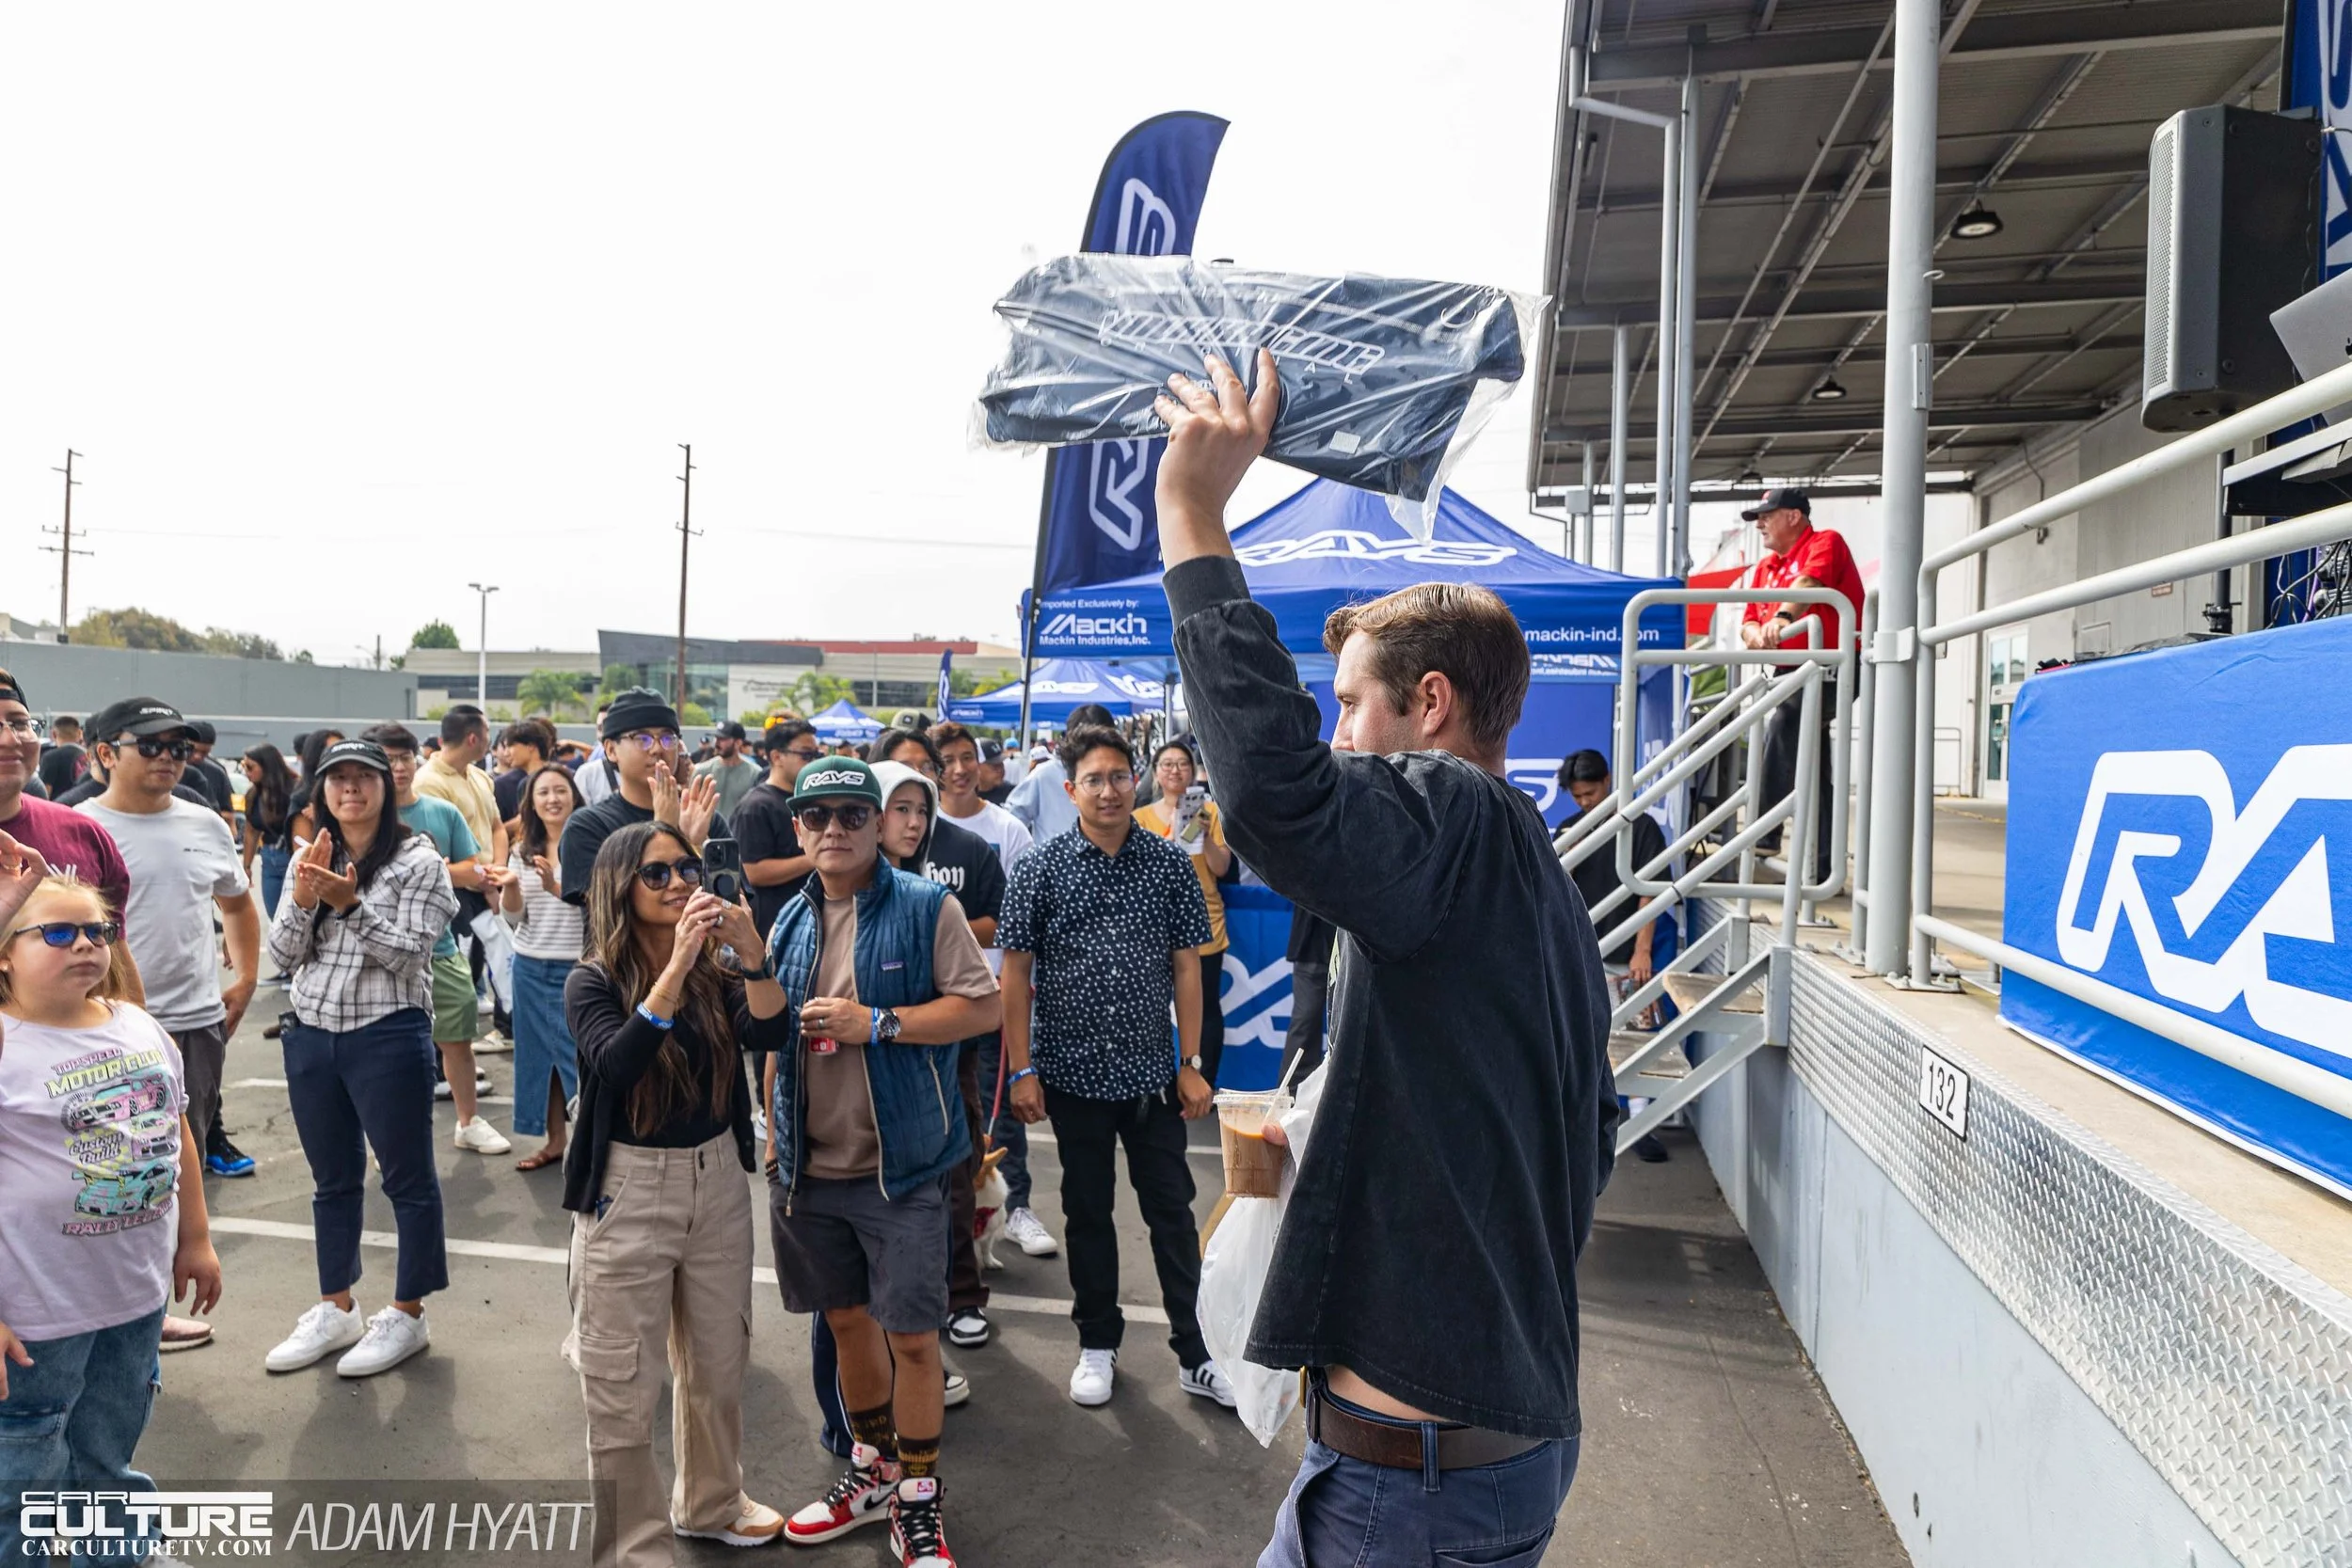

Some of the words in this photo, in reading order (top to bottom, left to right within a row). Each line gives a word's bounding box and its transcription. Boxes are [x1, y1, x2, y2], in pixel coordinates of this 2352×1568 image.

[1039, 599, 1076, 610] mported
[1077, 598, 1124, 610] Exclusively
[1040, 612, 1148, 635] Mackin
[1524, 626, 1660, 641] mackin-ind.om
[1039, 635, 1076, 645] Mackin
[802, 770, 866, 790] RAYS
[44, 1057, 122, 1099] MOTOR
[1929, 1060, 1956, 1121] 132
[69, 1131, 124, 1156] Custom
